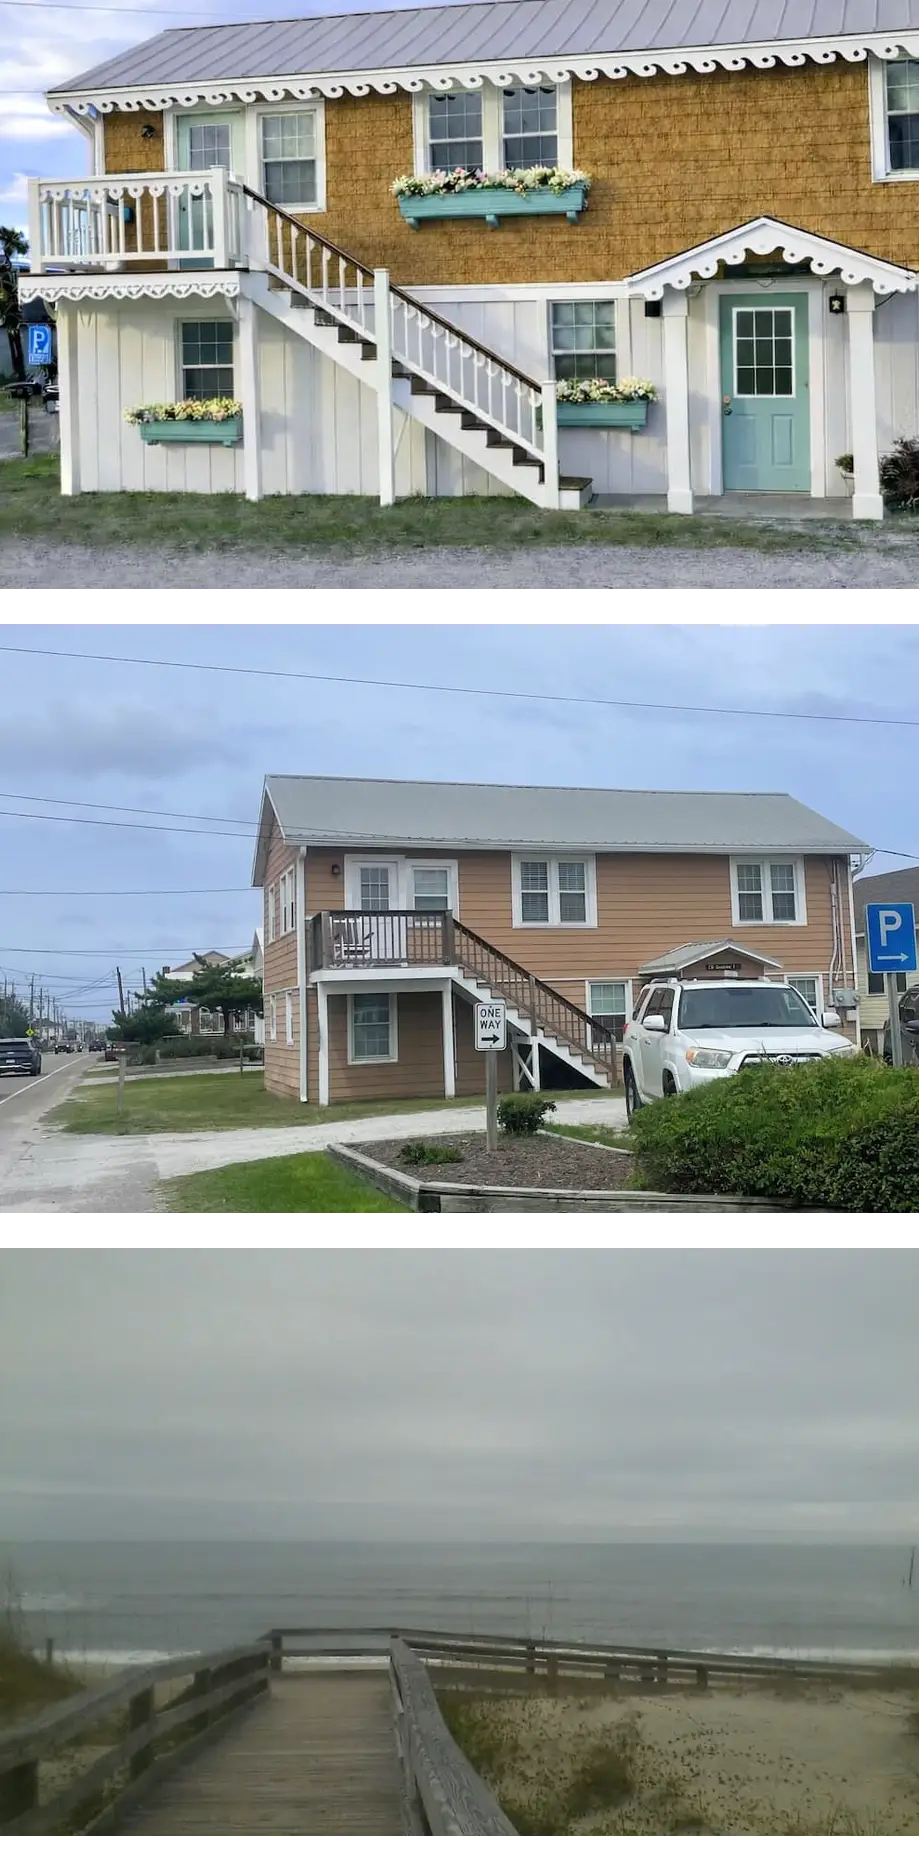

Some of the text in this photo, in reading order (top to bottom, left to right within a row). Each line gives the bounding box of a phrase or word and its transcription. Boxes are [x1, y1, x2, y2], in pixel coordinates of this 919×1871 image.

[33, 329, 46, 350] P
[879, 910, 902, 947] P
[480, 1008, 501, 1018] ONE
[480, 1020, 501, 1029] WAY
